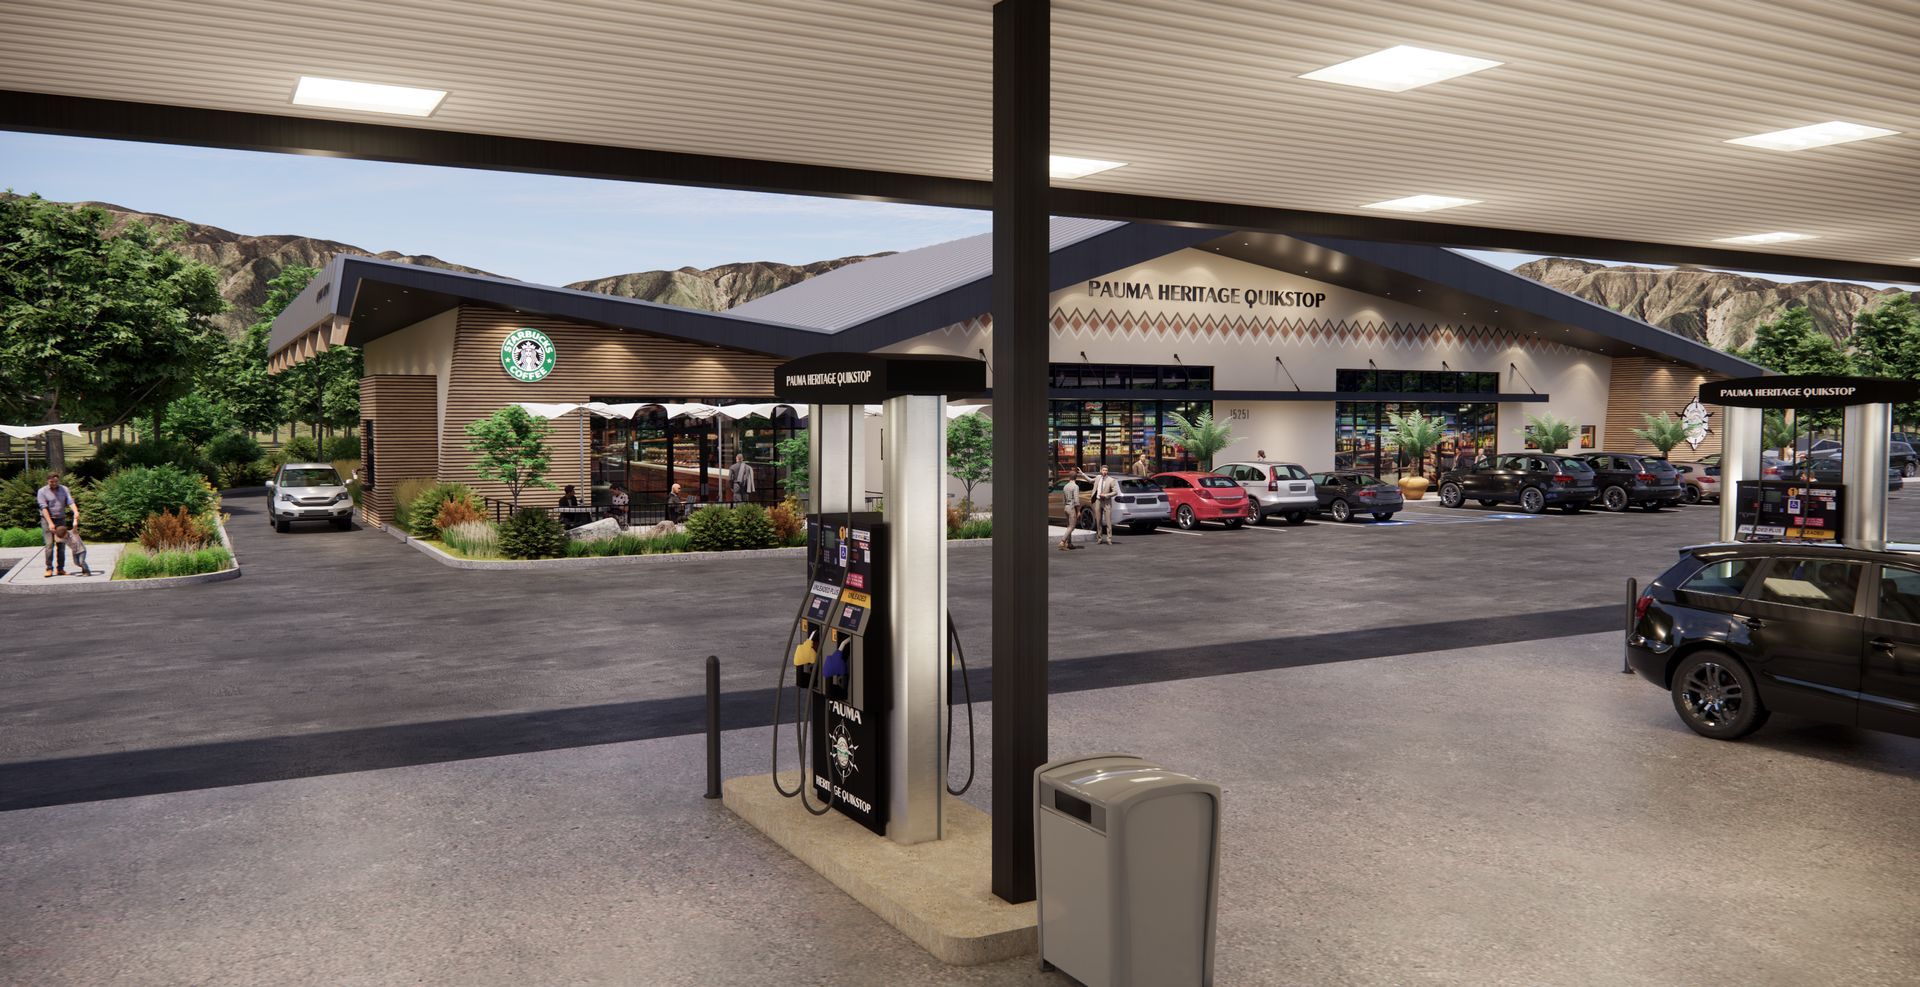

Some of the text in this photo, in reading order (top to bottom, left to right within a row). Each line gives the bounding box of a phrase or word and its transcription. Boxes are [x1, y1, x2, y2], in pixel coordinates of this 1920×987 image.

[1088, 280, 1326, 308] PAUMA HERITAGE QUIKSTOP
[504, 330, 553, 353] STARBUCKS
[510, 366, 547, 380] COFFEE
[786, 370, 871, 387] PAUMA HERITAGE QUIKSTOP
[1720, 387, 1856, 397] PAUMA HERITAGE QUIKSTOP
[1230, 409, 1250, 420] 15251
[815, 774, 872, 814] HERITGE QUIKSTOP
